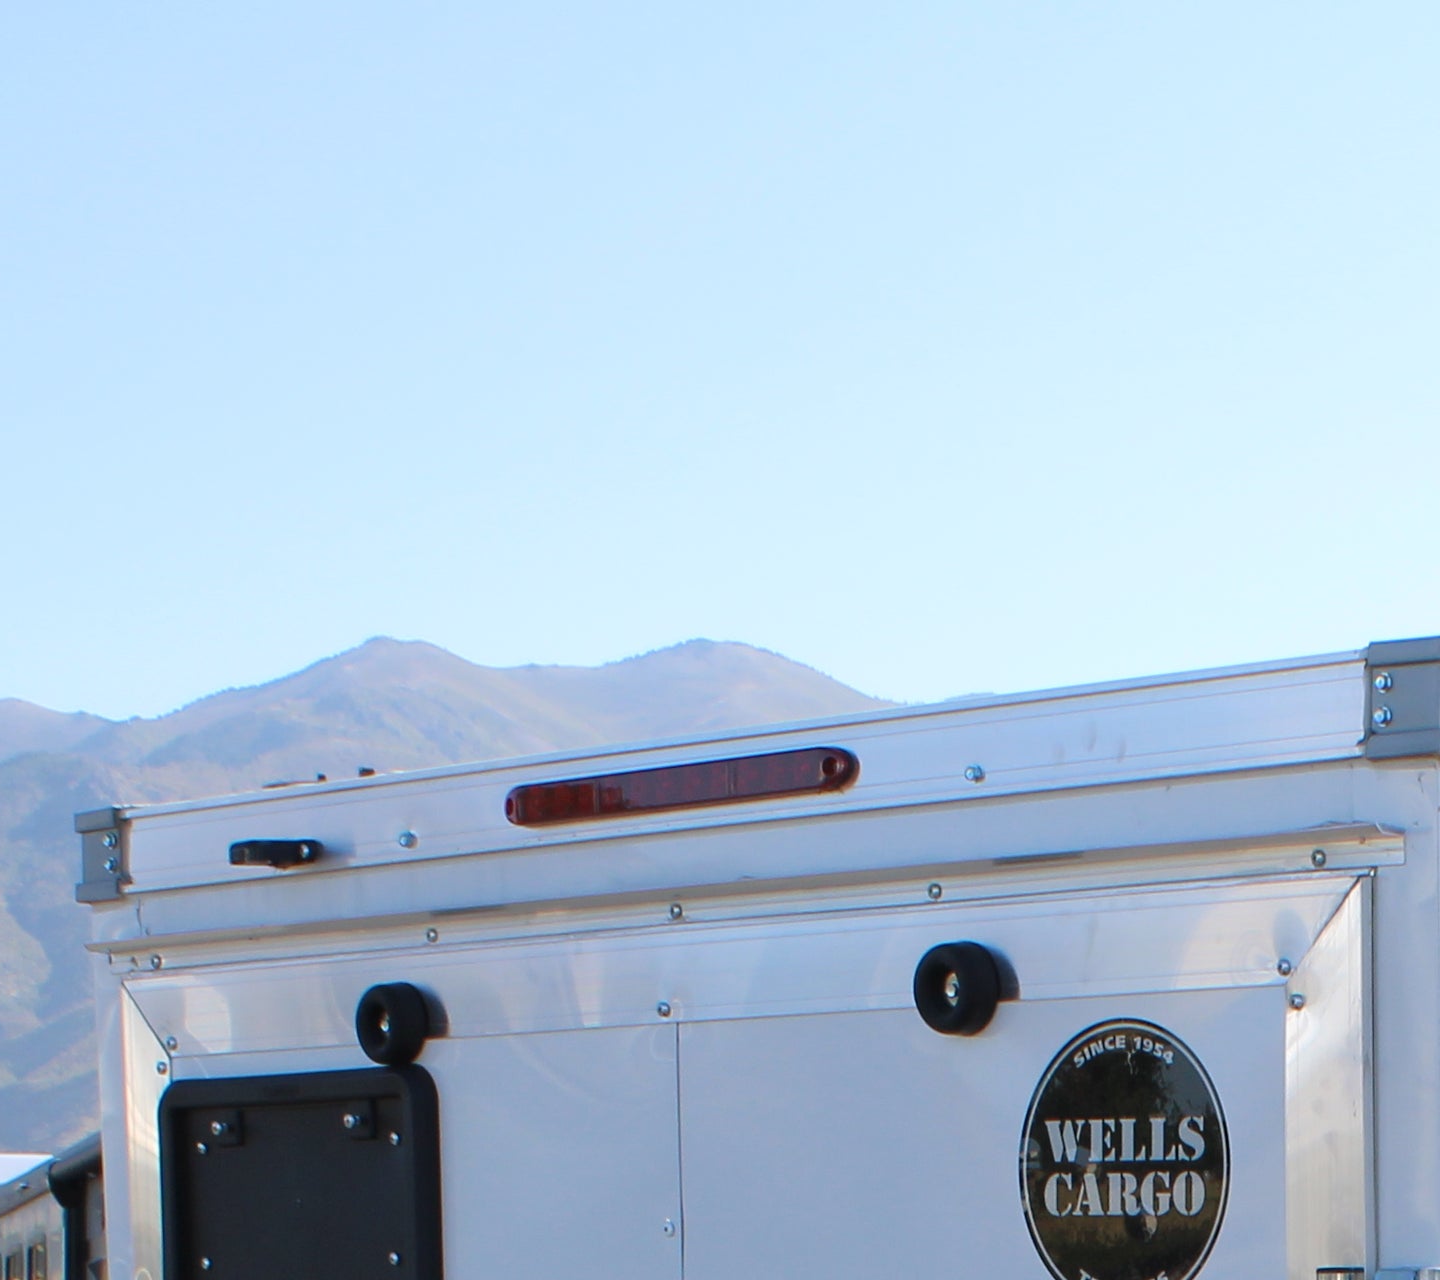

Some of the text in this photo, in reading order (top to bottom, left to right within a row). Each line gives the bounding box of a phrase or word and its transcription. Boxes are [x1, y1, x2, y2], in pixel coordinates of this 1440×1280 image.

[1073, 1035, 1174, 1068] SINCE 1954
[1044, 1115, 1205, 1163] WELLS
[1044, 1170, 1206, 1217] CARGO
